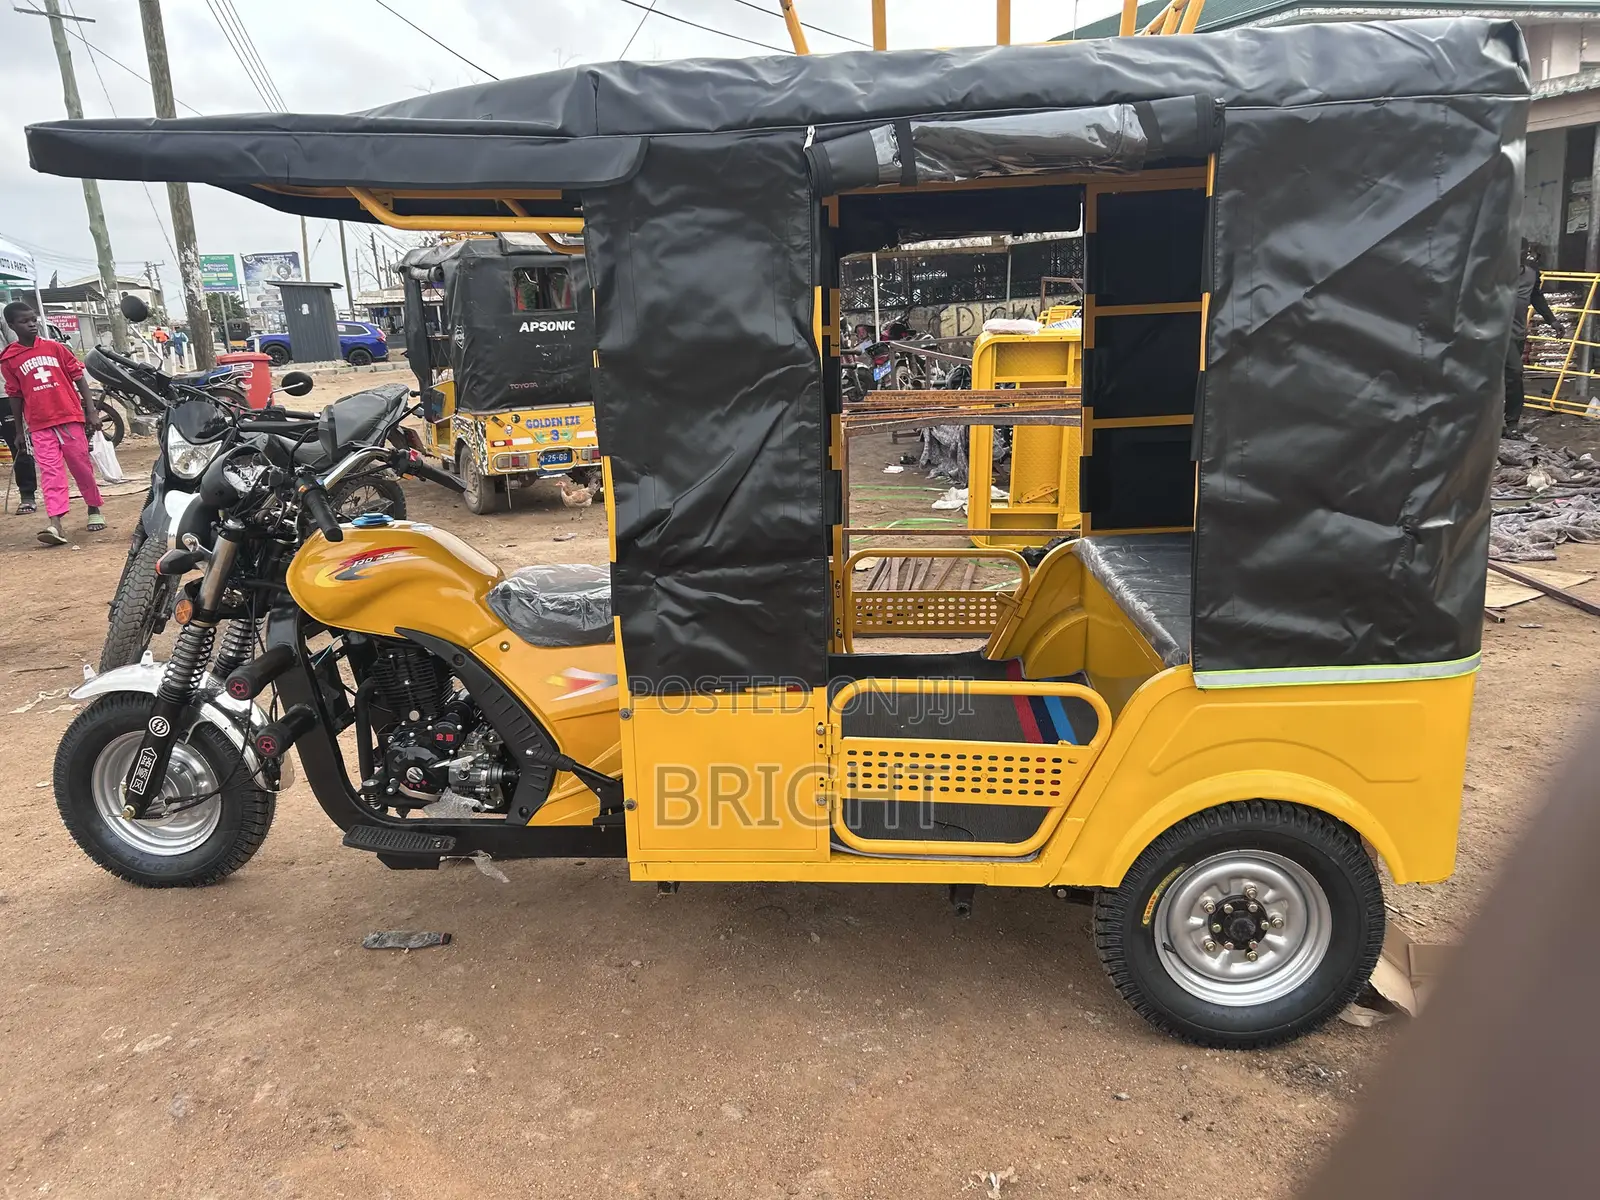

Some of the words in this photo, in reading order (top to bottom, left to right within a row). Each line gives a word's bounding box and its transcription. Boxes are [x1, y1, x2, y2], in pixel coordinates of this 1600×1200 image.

[519, 320, 576, 333] APSONIC
[20, 356, 60, 376] LIFEGUARD
[509, 382, 539, 390] TOYOTA
[525, 418, 563, 429] GOLDEN
[564, 416, 581, 425] EZE
[550, 429, 560, 442] 3
